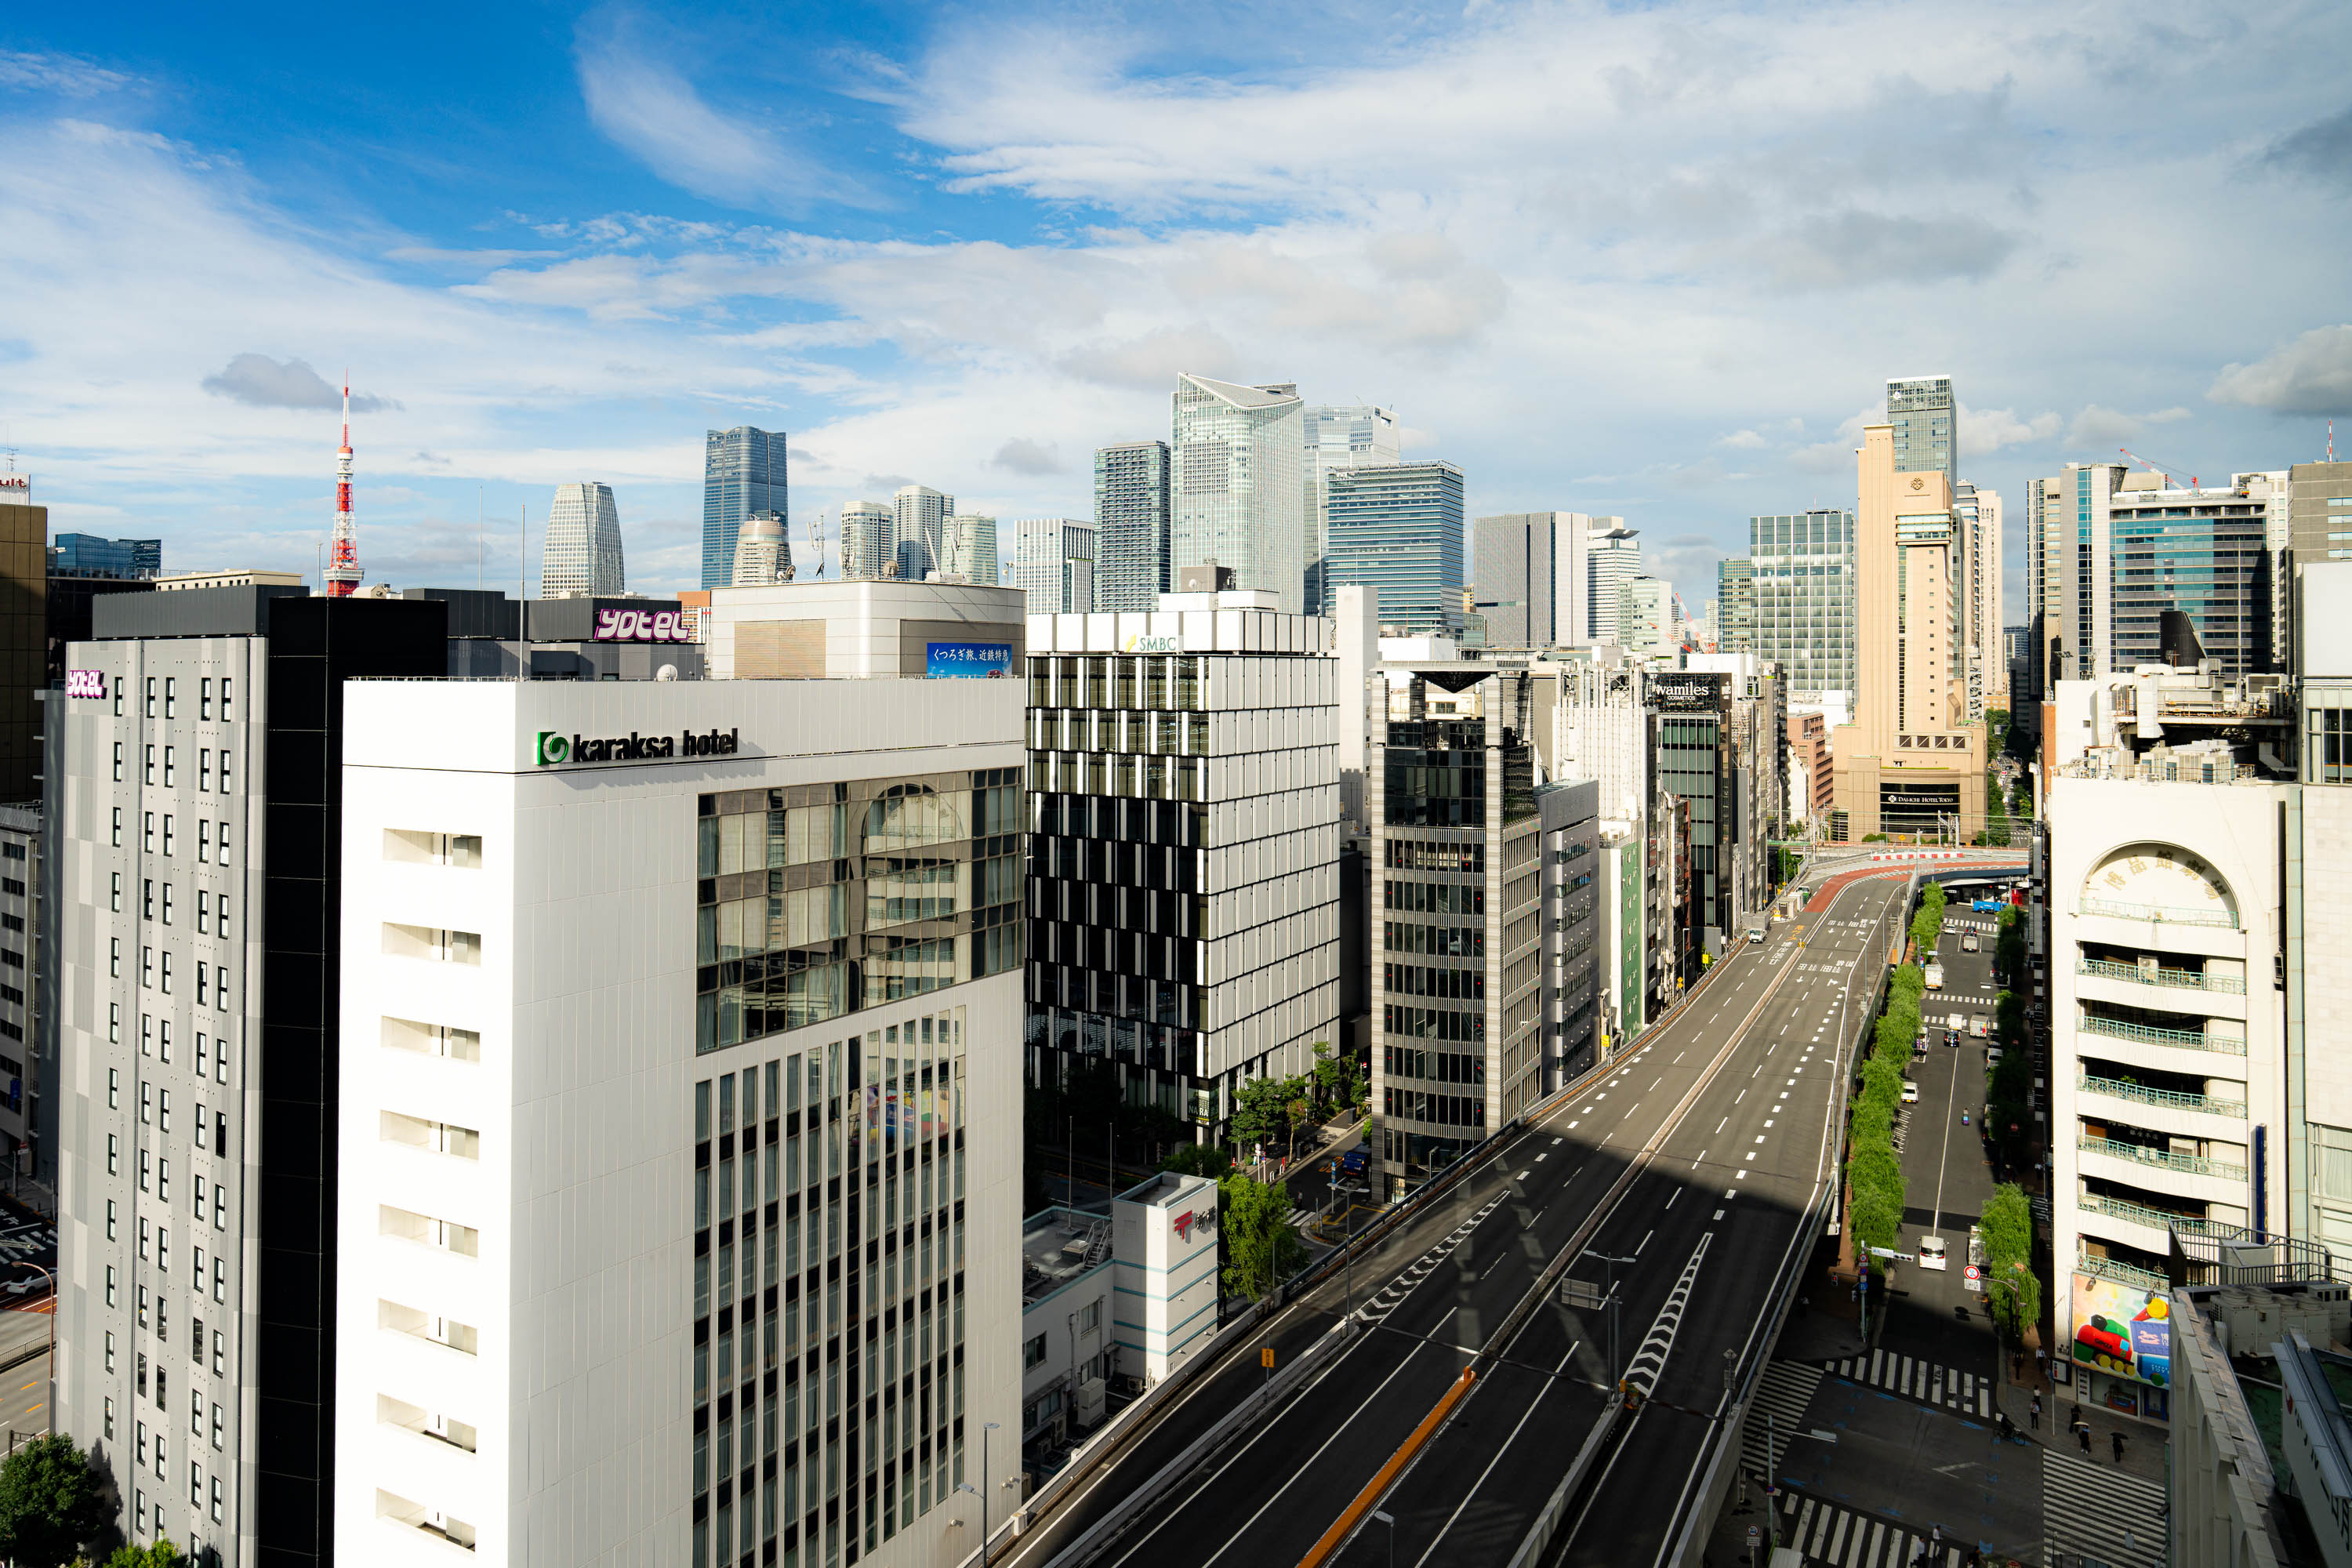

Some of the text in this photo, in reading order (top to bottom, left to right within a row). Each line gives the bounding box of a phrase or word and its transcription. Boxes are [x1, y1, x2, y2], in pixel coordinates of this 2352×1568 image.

[1140, 637, 1176, 652] SMBC
[1655, 681, 1709, 696] wamiles
[573, 728, 739, 763] karaksa hotel
[2094, 1338, 2113, 1349] GINZA
